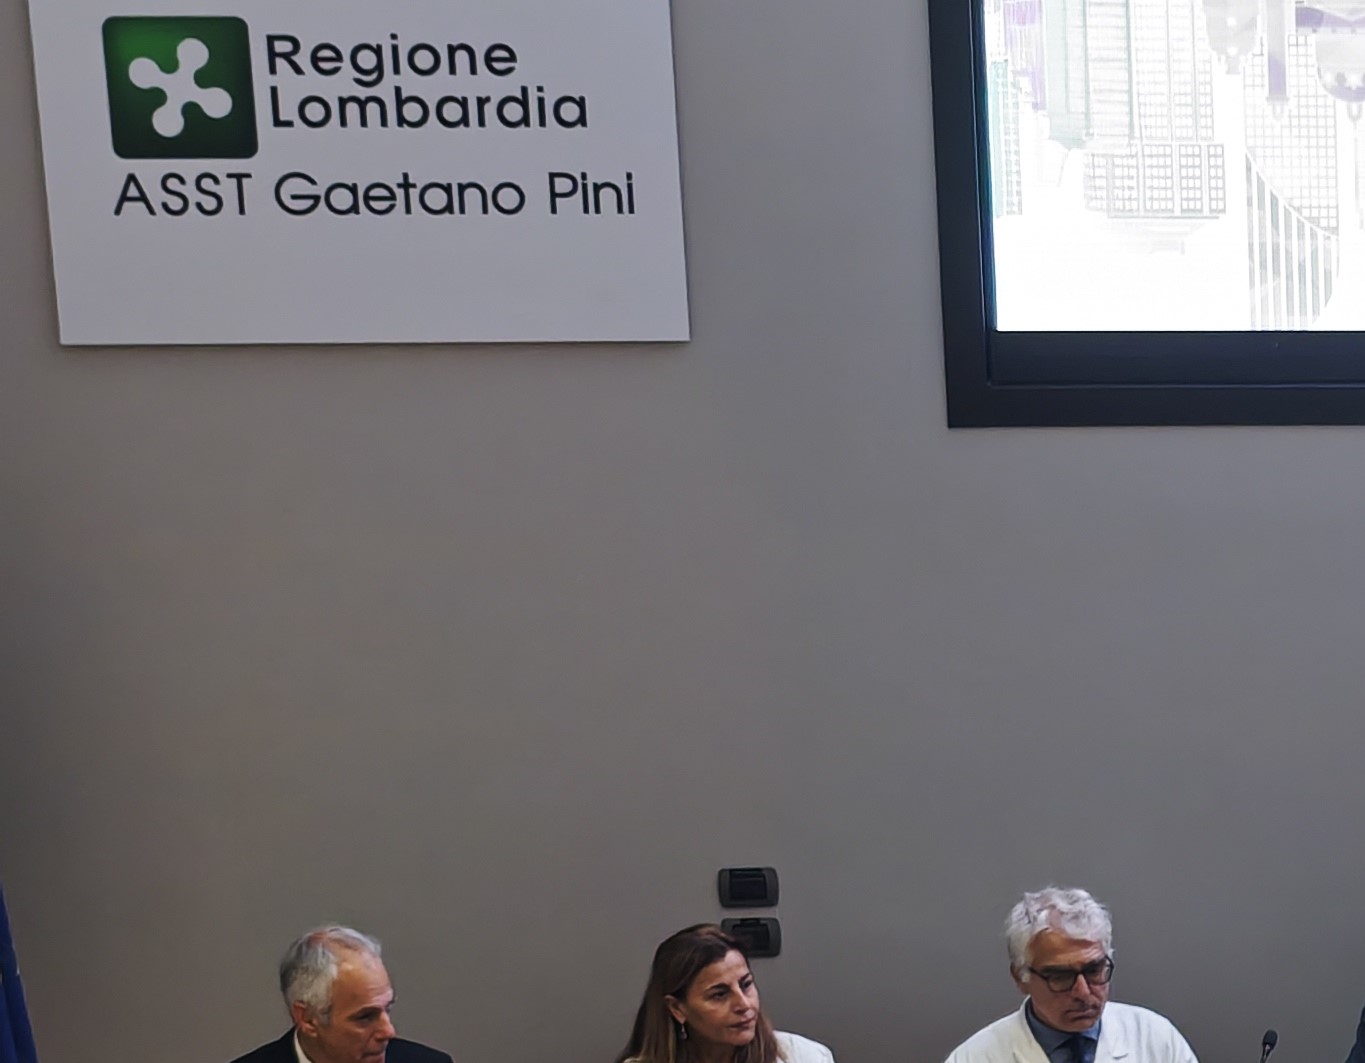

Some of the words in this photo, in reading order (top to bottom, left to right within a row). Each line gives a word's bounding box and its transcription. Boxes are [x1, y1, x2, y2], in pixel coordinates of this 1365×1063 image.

[266, 34, 519, 88] Regione
[270, 85, 588, 129] Lombardia
[113, 172, 253, 217] ASST
[273, 171, 527, 217] Gaetano
[547, 171, 636, 216] Pini
